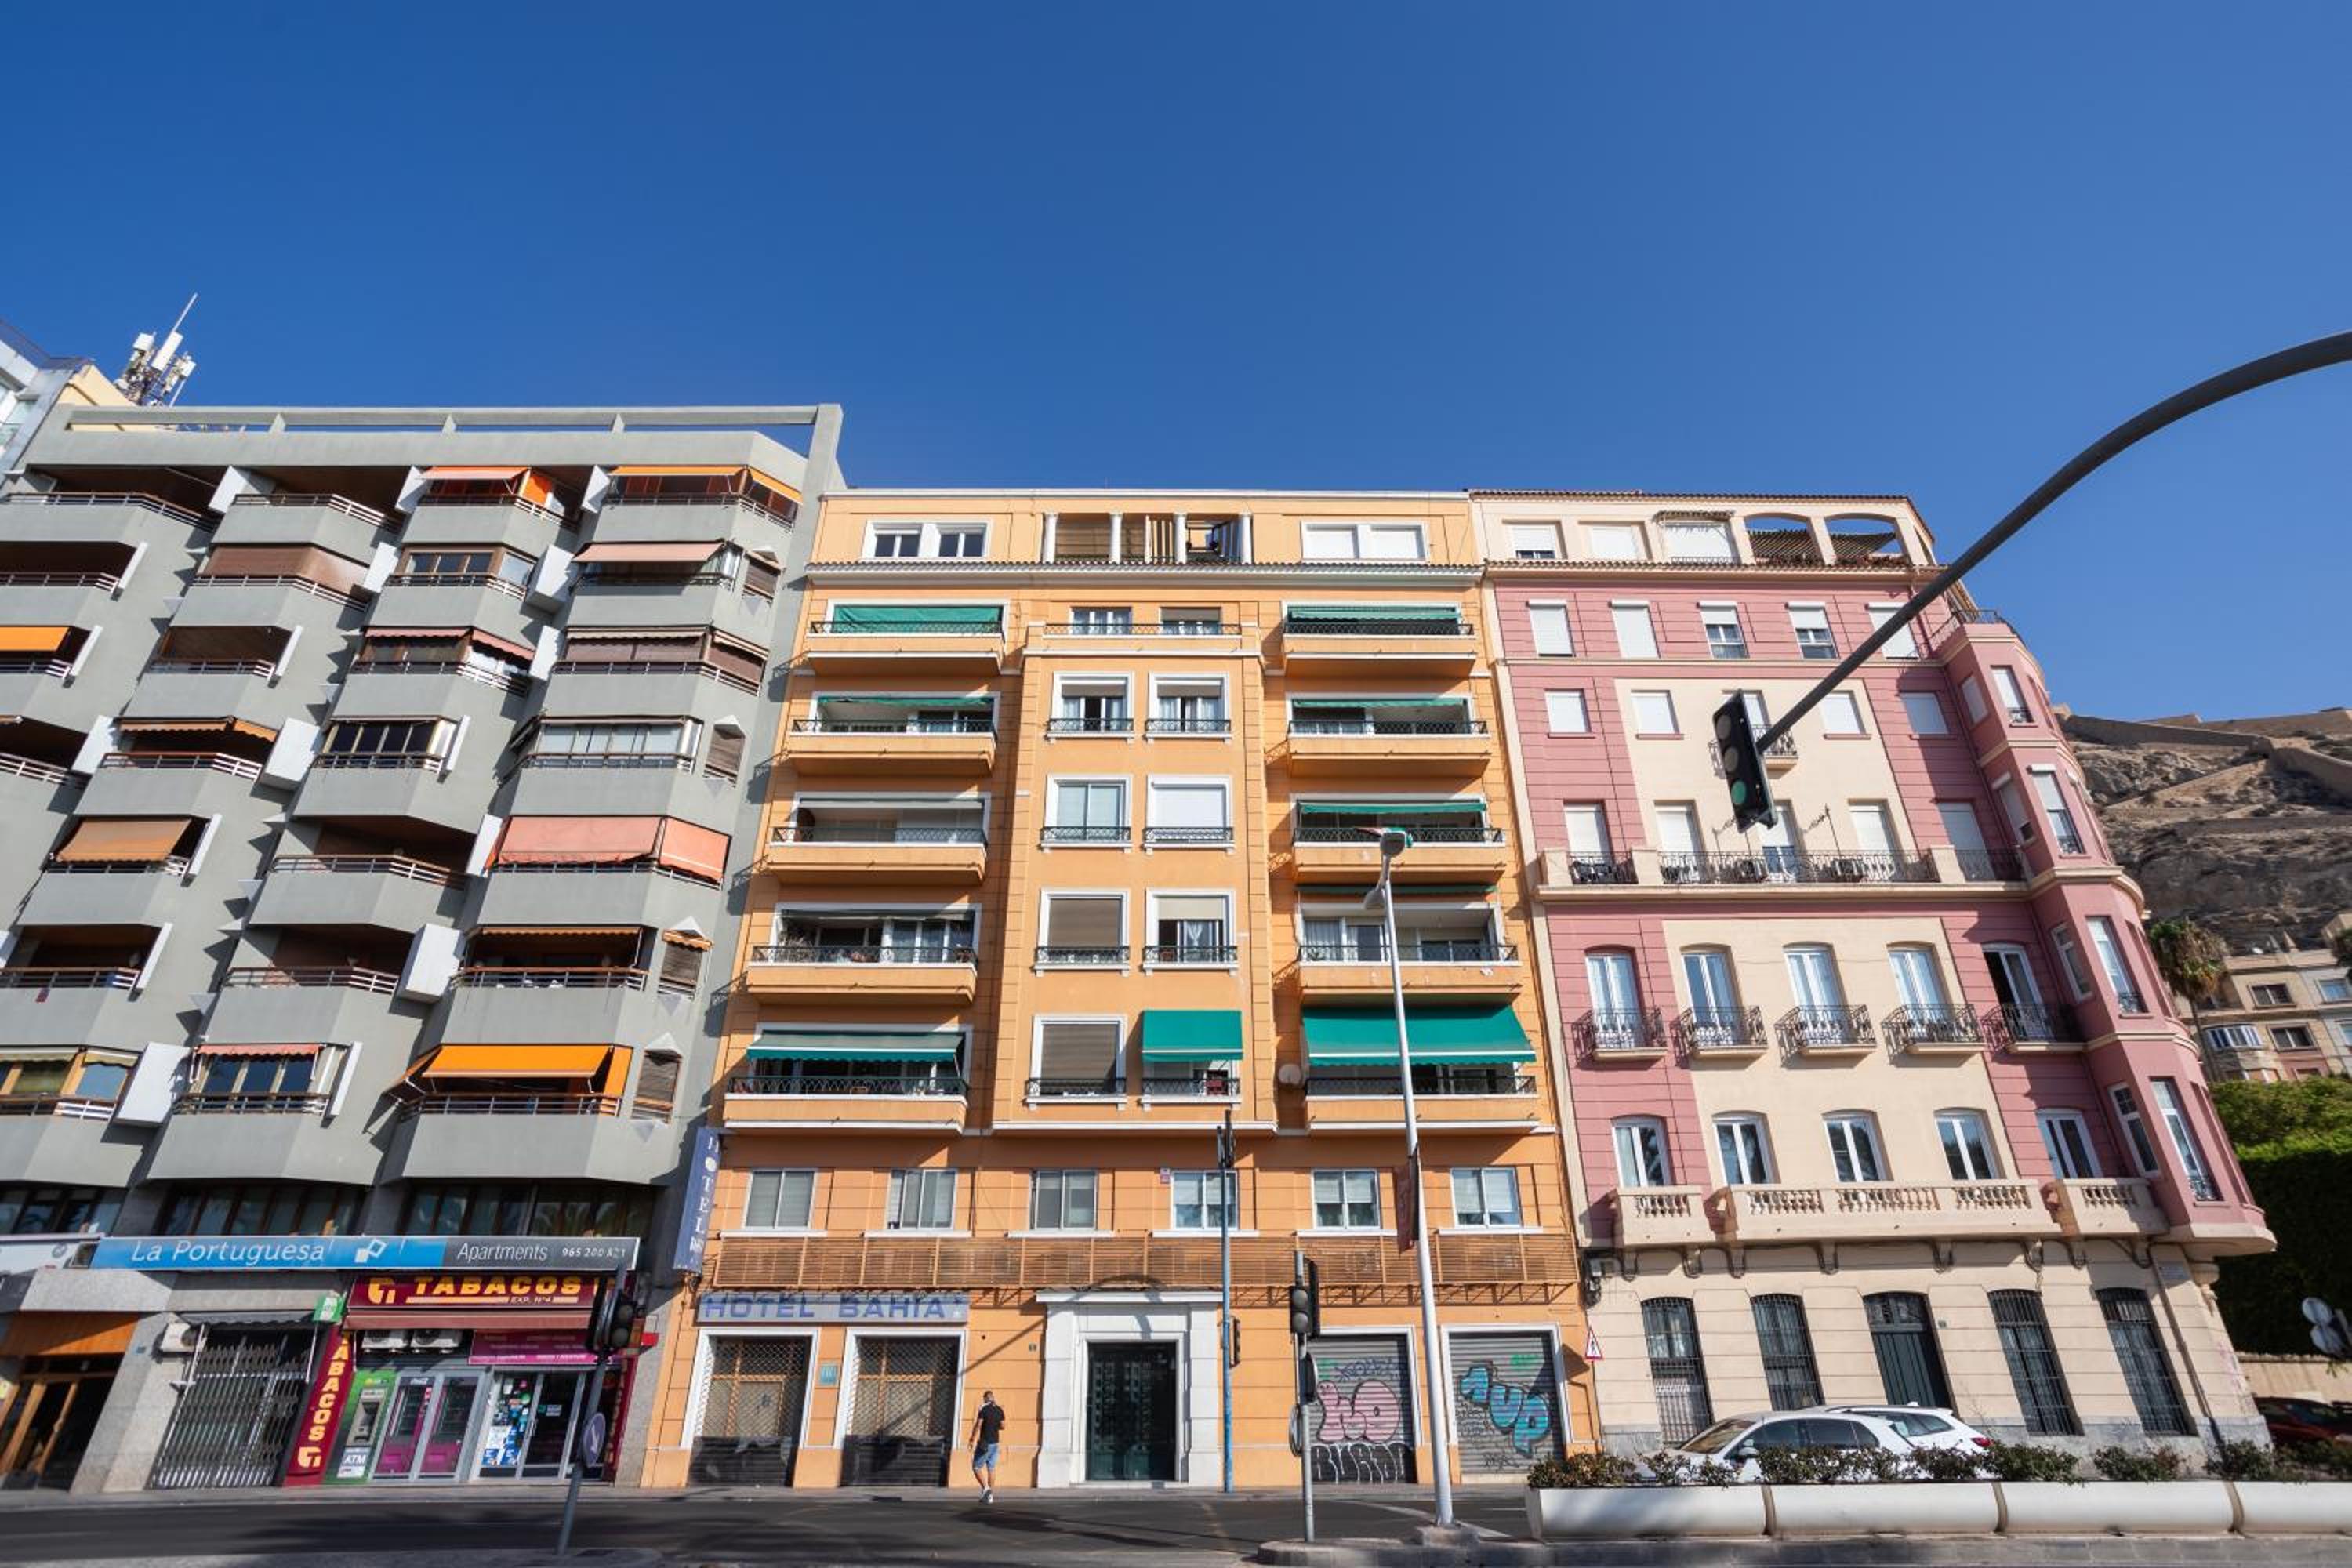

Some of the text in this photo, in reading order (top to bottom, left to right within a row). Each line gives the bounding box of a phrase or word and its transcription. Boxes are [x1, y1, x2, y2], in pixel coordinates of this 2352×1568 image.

[695, 1138, 720, 1235] HOTEL
[132, 1240, 325, 1266] La Portuguesa
[457, 1243, 548, 1263] Apartments
[562, 1247, 582, 1258] 965
[414, 1276, 582, 1295] TABACOS
[705, 1297, 815, 1319] HOTEL
[344, 1454, 366, 1464] ATM
